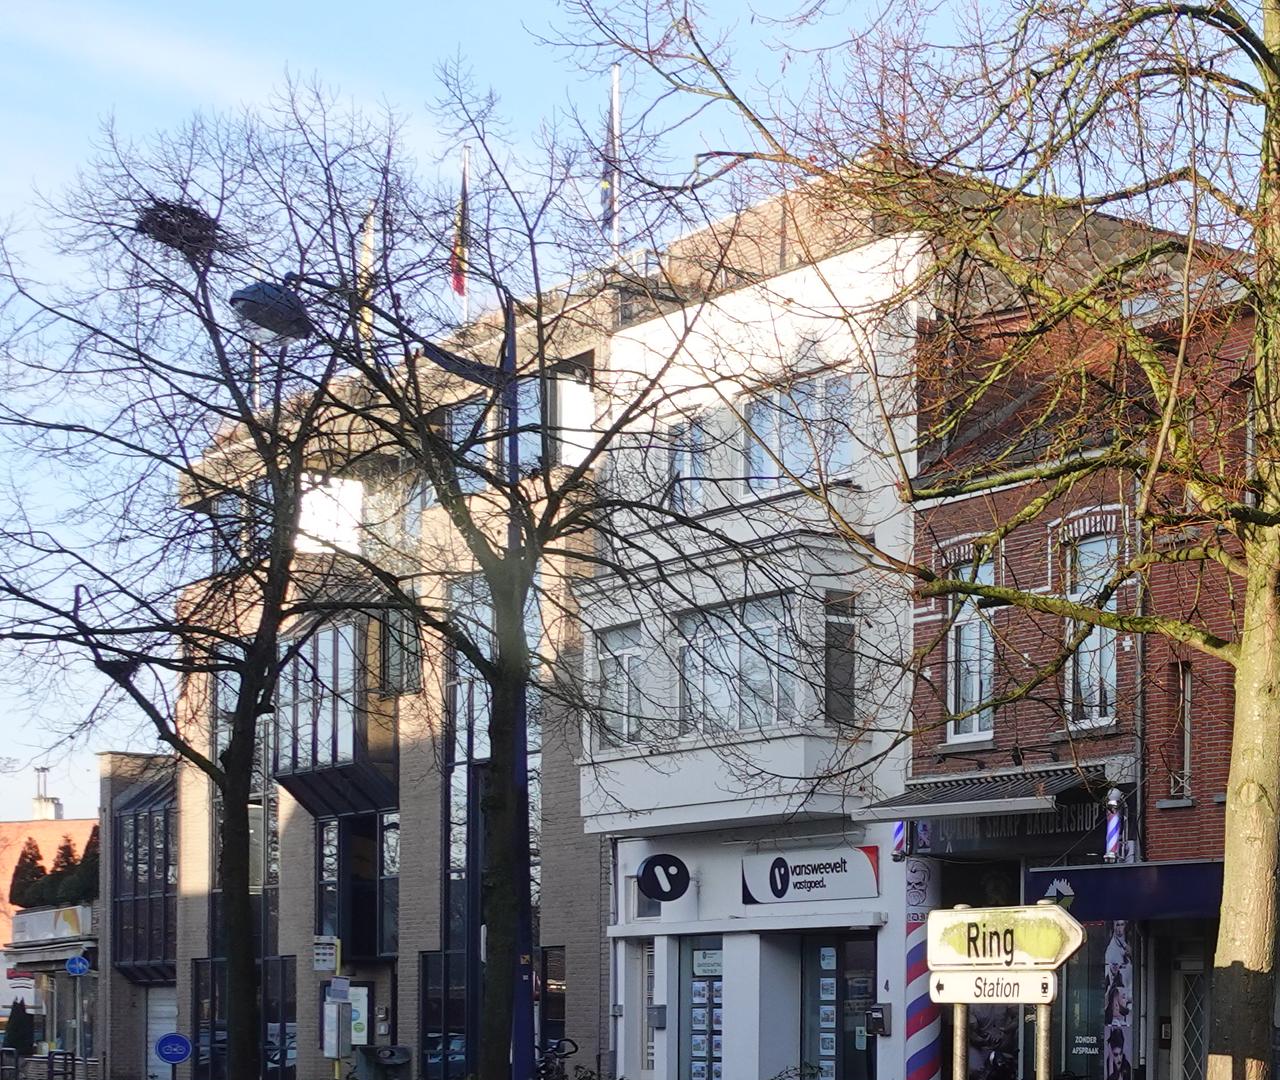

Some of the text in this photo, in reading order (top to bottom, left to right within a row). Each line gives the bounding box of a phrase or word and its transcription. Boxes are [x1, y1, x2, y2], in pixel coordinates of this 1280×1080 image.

[1026, 802, 1100, 836] BARBERSHOP
[790, 857, 848, 877] vansweevelt
[967, 922, 1014, 966] Ring
[974, 976, 1020, 999] Station
[1075, 1036, 1097, 1044] ZONDER
[1071, 1047, 1099, 1055] AFSPRAAK
